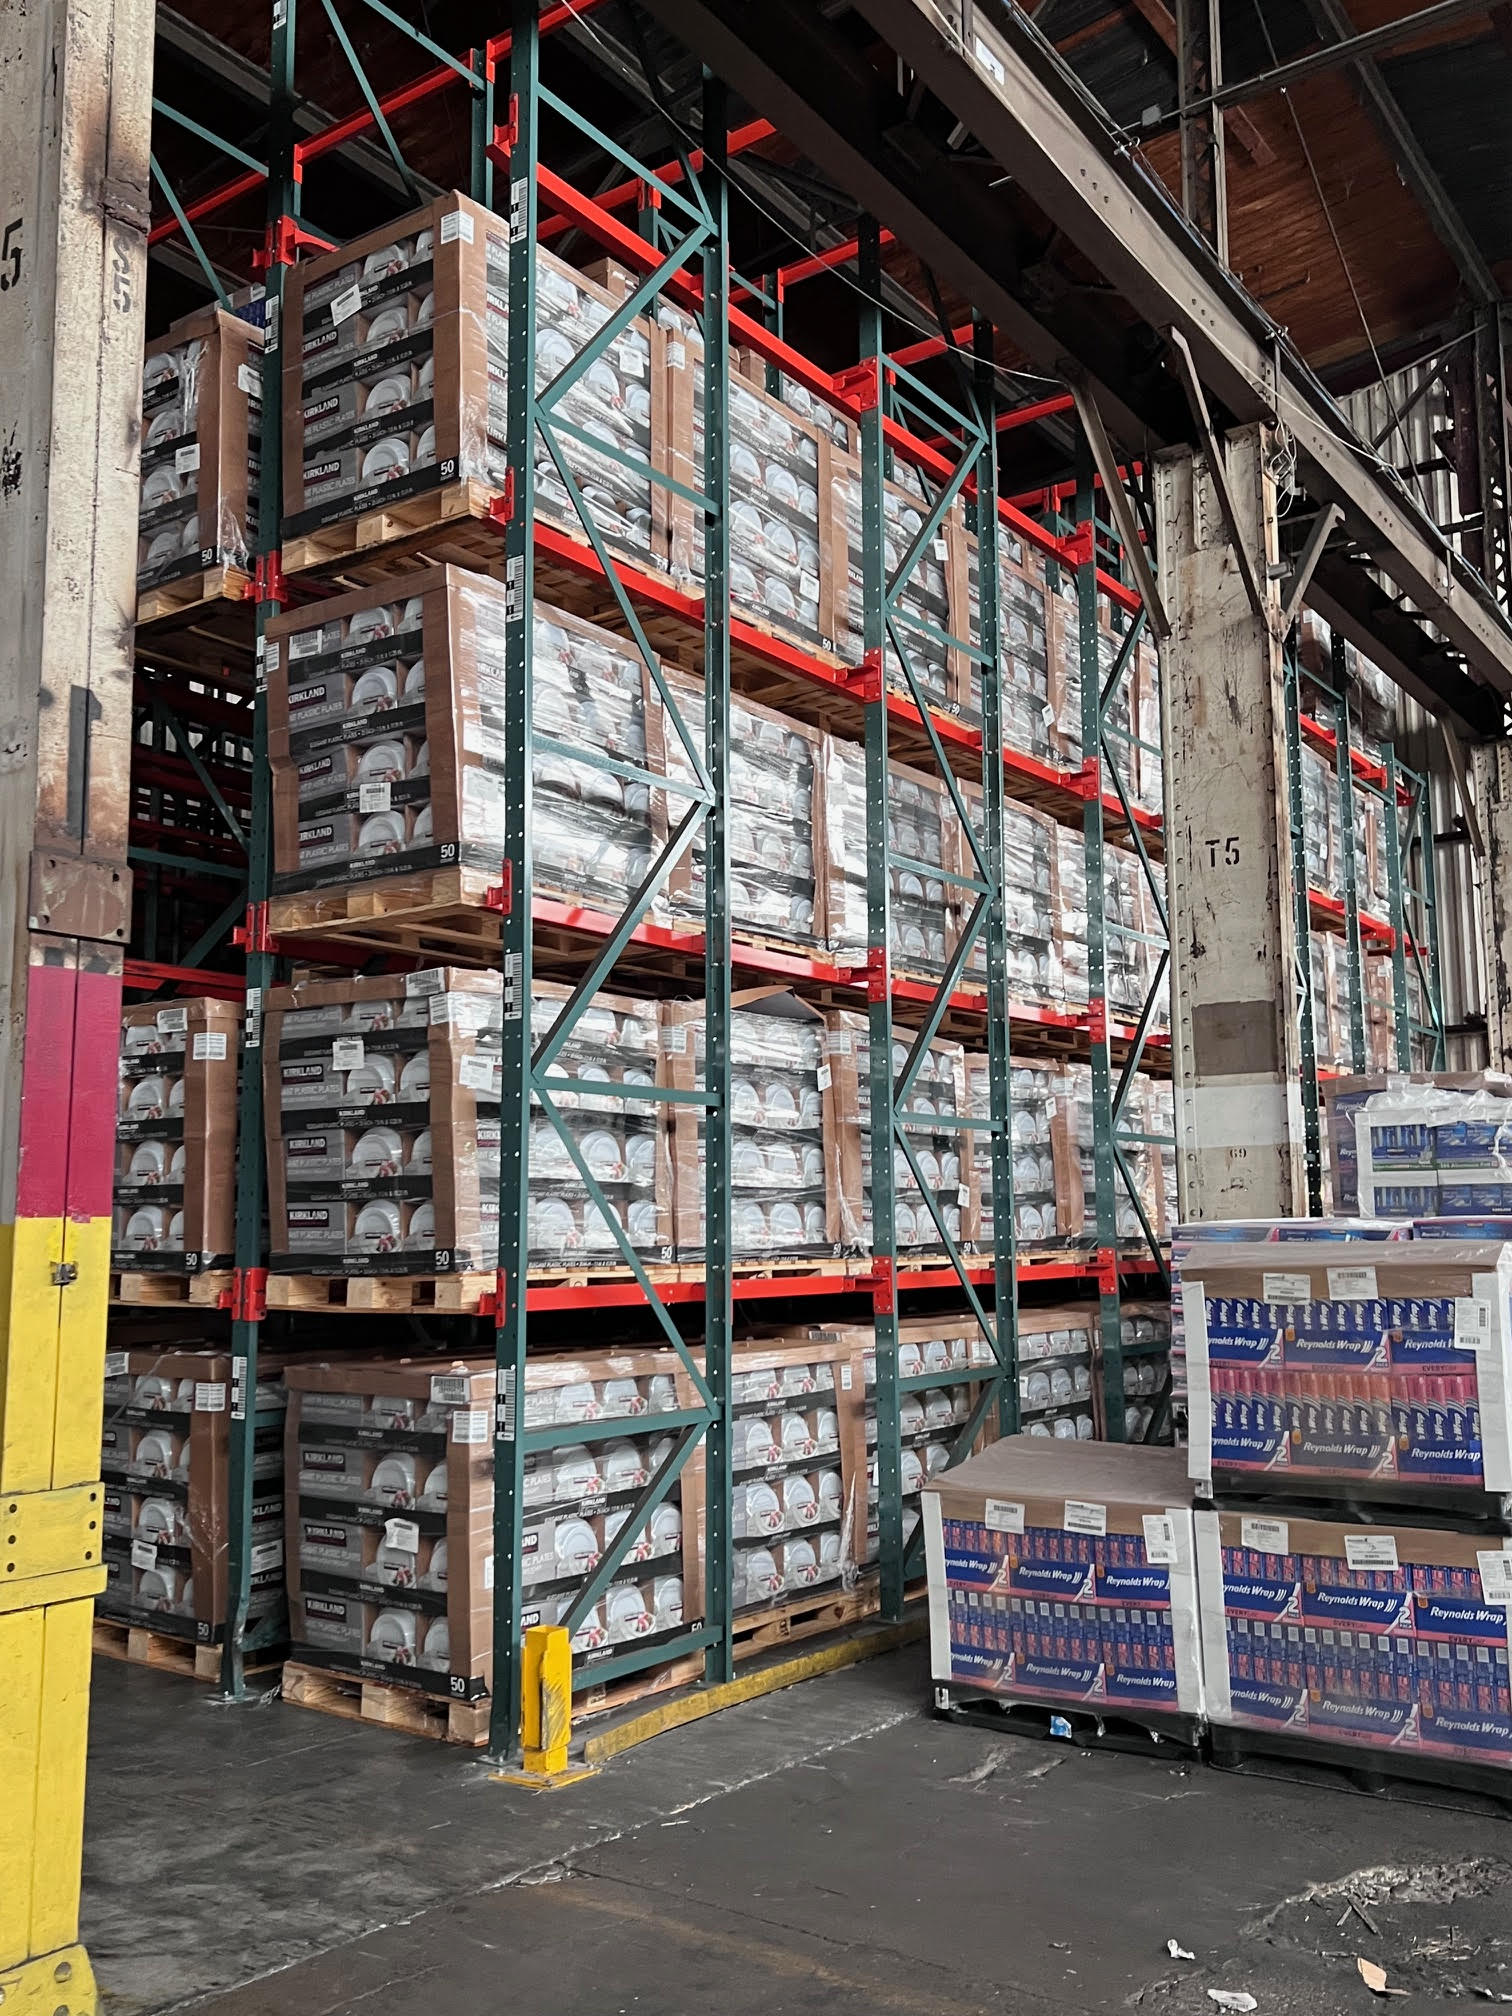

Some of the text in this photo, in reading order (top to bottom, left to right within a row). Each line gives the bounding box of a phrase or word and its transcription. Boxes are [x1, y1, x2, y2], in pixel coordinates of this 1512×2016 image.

[303, 397, 339, 418] KIRKLAND
[302, 462, 340, 479] KIRKLAND
[440, 459, 455, 475] 50
[202, 548, 212, 561] 50
[822, 639, 832, 651] 50
[288, 686, 325, 704] KIRKLAND
[300, 758, 331, 774] KIRKLAND
[440, 844, 455, 858] 50
[1205, 836, 1240, 867] T5
[283, 1065, 323, 1077] KIRKLAND
[289, 1138, 326, 1149] KIRKLAND
[289, 1210, 328, 1221] KIRKLAND
[185, 1253, 197, 1266] 50
[434, 1251, 449, 1265] 50
[661, 1245, 673, 1259] 50
[1207, 1336, 1258, 1349] ynolds Wrap
[1296, 1338, 1362, 1353] Reynolds Wrap
[1404, 1339, 1447, 1351] Reynolds
[1270, 1344, 1281, 1360] 2
[1375, 1346, 1388, 1362] 2
[1212, 1437, 1264, 1450] ynolds Wrap
[1303, 1442, 1368, 1456] Reynolds Wrap
[305, 1452, 343, 1464] KIRKLAND
[1276, 1446, 1288, 1461] 2
[1381, 1452, 1394, 1468] 2
[1411, 1447, 1480, 1462] Reynolds Wrap
[305, 1527, 345, 1540] KIRKLAND
[945, 1558, 988, 1571] ynolds Wrap
[997, 1569, 1008, 1584] 2
[1019, 1566, 1073, 1582] Reynolds Wrap
[1083, 1579, 1095, 1595] 2
[1106, 1575, 1165, 1590] Reynolds Wrap
[1222, 1583, 1275, 1598] ynolds Wrap
[307, 1600, 345, 1615] KIRKLAND
[1287, 1596, 1299, 1613] 2
[1317, 1591, 1384, 1610] Reynolds Wrap
[1399, 1607, 1412, 1624] 2
[1430, 1606, 1503, 1625] Reynolds Wrap
[587, 1648, 613, 1660] KIRKLAND
[951, 1652, 994, 1668] ynolds Wrap
[1003, 1666, 1014, 1681] 2
[1026, 1663, 1082, 1681] Reynolds Wrap
[450, 1676, 465, 1693] 50
[1093, 1676, 1104, 1693] 2
[1116, 1674, 1175, 1688] Reynolds Wrap
[1229, 1689, 1282, 1706] ynolds Wrap
[1294, 1704, 1306, 1722] 2
[1322, 1699, 1390, 1720] Reynolds Wrap
[1405, 1718, 1418, 1735] 2
[1435, 1716, 1510, 1735] Reynolds Wrap
